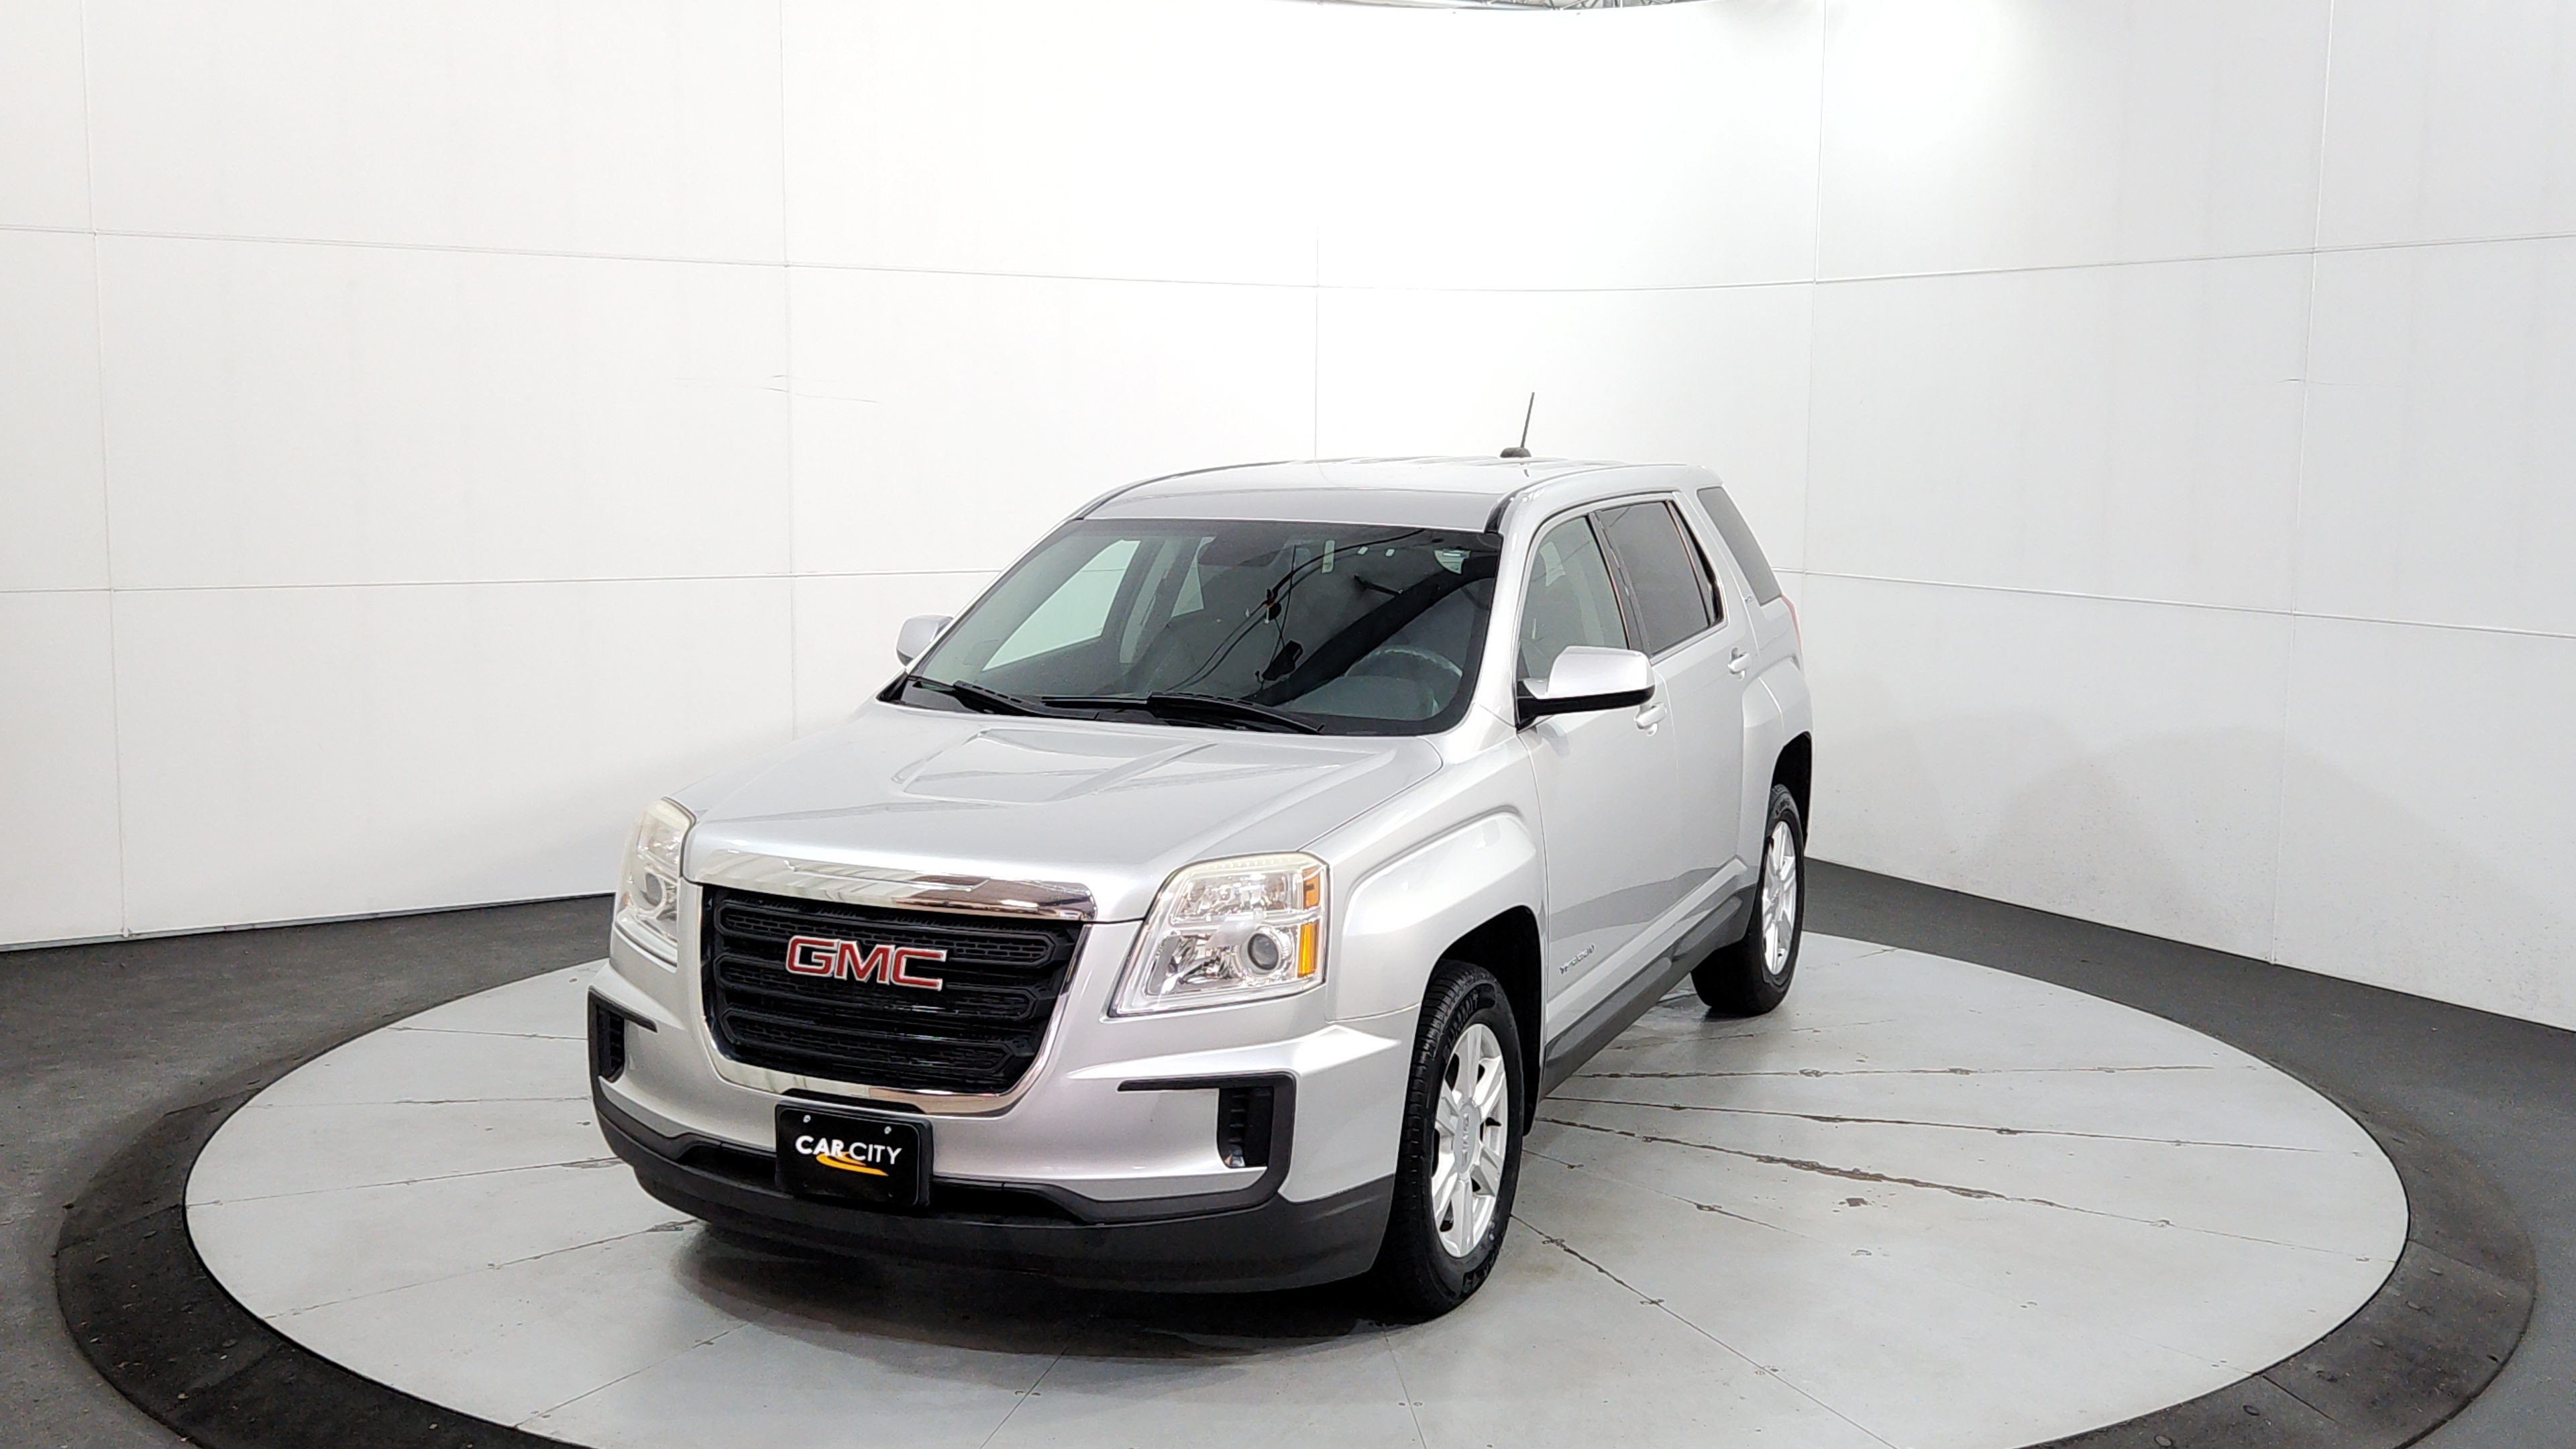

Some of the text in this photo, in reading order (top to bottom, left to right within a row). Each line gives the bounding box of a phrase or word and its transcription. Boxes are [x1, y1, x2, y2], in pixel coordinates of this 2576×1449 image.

[786, 935, 948, 991] GMC
[795, 1135, 902, 1165] CAR CITY
